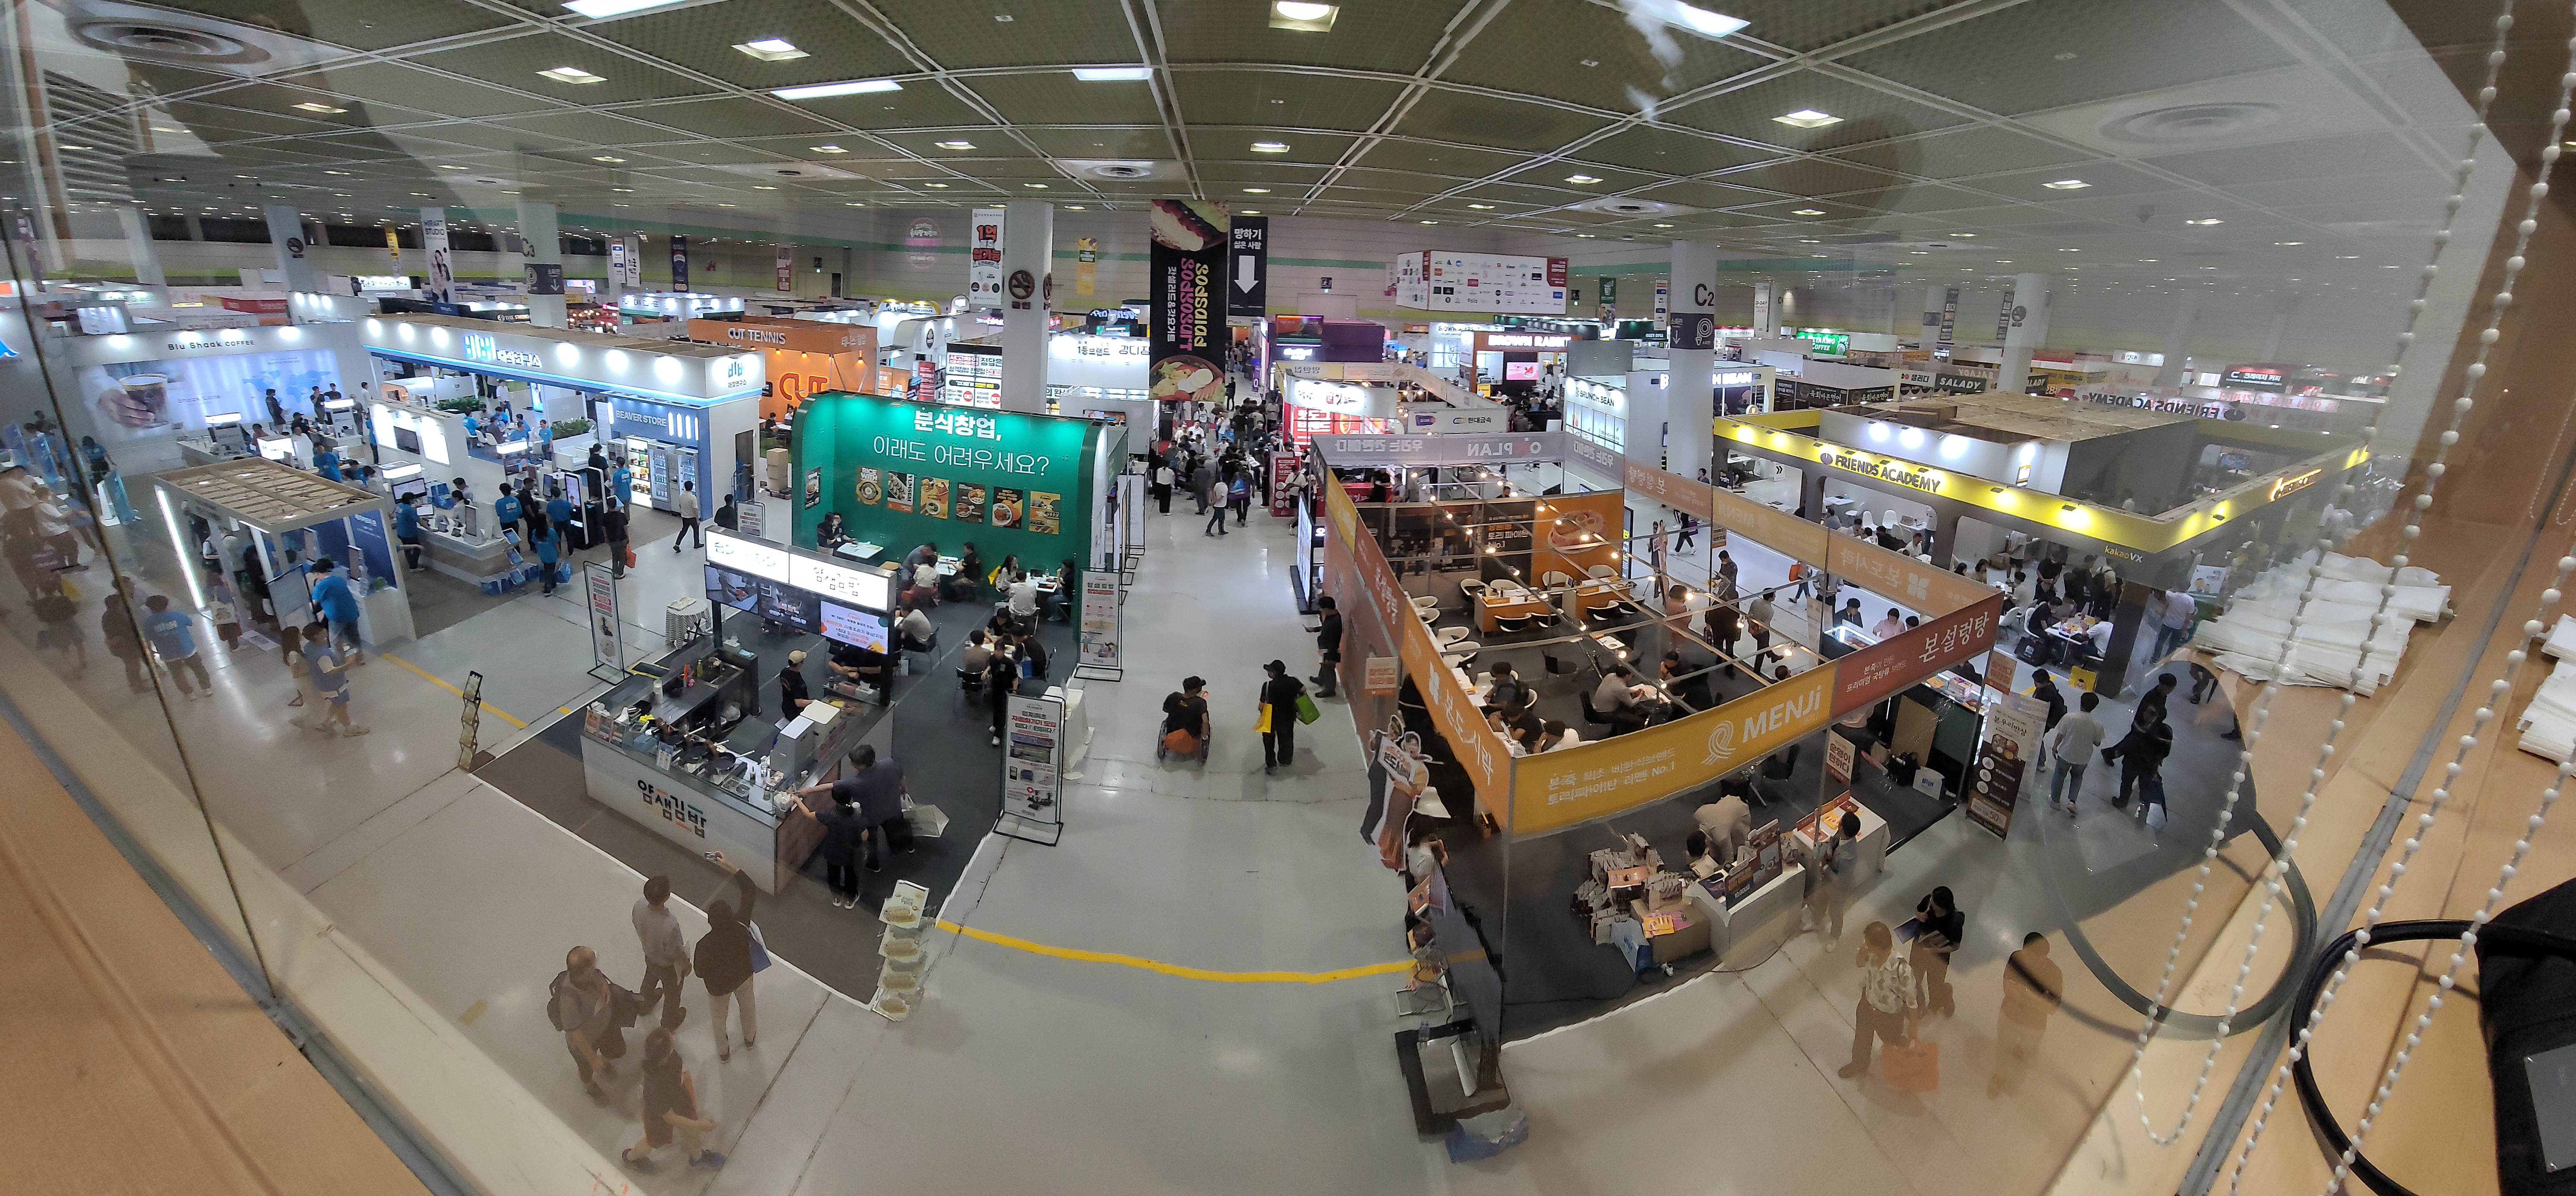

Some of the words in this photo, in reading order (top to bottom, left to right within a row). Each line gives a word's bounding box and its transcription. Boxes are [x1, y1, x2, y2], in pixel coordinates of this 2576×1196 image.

[1234, 228, 1262, 240] 망하기
[1247, 241, 1262, 250] 사람
[1695, 283, 1714, 307] C2
[727, 328, 746, 340] CUT
[748, 329, 787, 345] TENNIS
[1077, 346, 1110, 356] 1등브랜드
[981, 357, 1003, 367] 정답은
[1939, 377, 1981, 390] SALADY
[1580, 390, 1599, 403] BRUNCH
[1600, 396, 1614, 407] BEAN
[1810, 389, 1842, 402] 육회바른연어
[615, 410, 643, 423] BEAVER
[642, 415, 667, 427] STORE
[914, 409, 1002, 442] 분식창업,
[873, 435, 927, 462] 이래도
[934, 445, 1050, 476] 어려우세요?
[861, 467, 877, 475] RICE
[1835, 454, 1879, 477] FRIENDS
[1880, 466, 1941, 493] ACADEMY
[2105, 545, 2143, 563] kakaoVX
[1918, 611, 1990, 663] 본설렁탕
[1846, 675, 1871, 692] 프리미엄
[1742, 685, 1822, 744] MENJi
[1651, 762, 1676, 777] No.1
